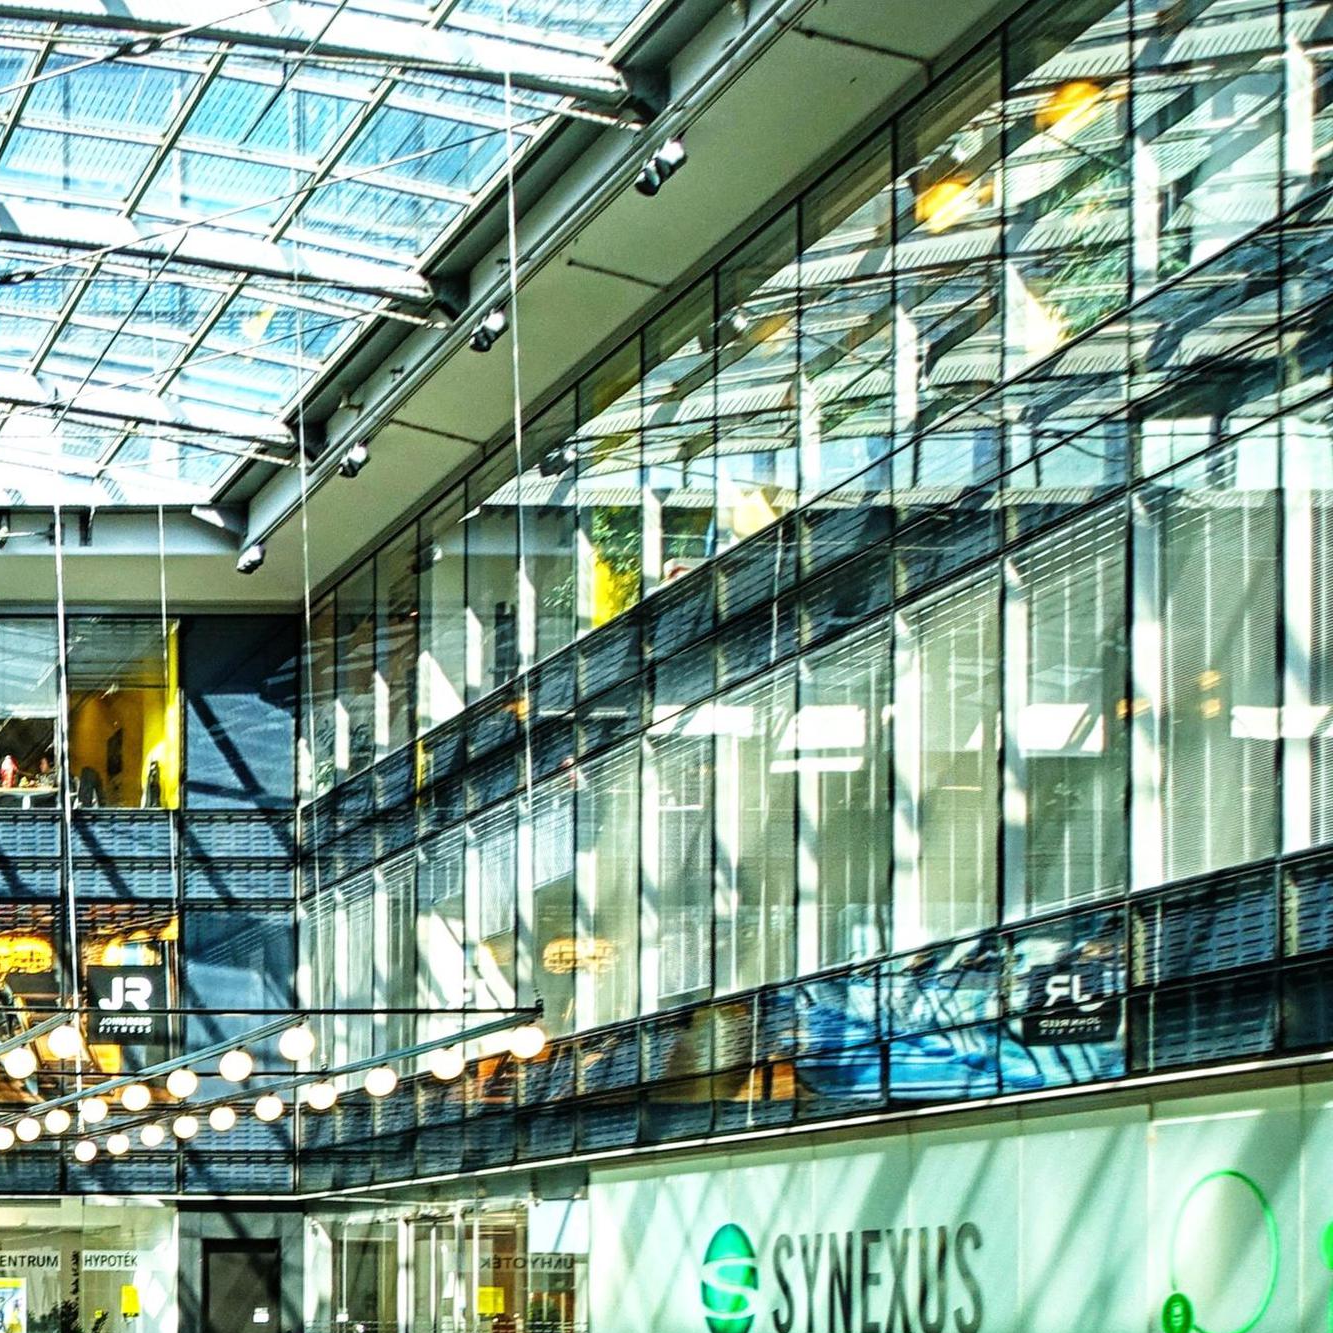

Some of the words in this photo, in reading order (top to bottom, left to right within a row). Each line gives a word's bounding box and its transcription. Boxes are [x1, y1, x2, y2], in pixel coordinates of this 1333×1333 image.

[98, 976, 152, 1011] JR
[98, 1025, 152, 1034] FITNESS
[84, 1251, 138, 1268] HYPOTÉK
